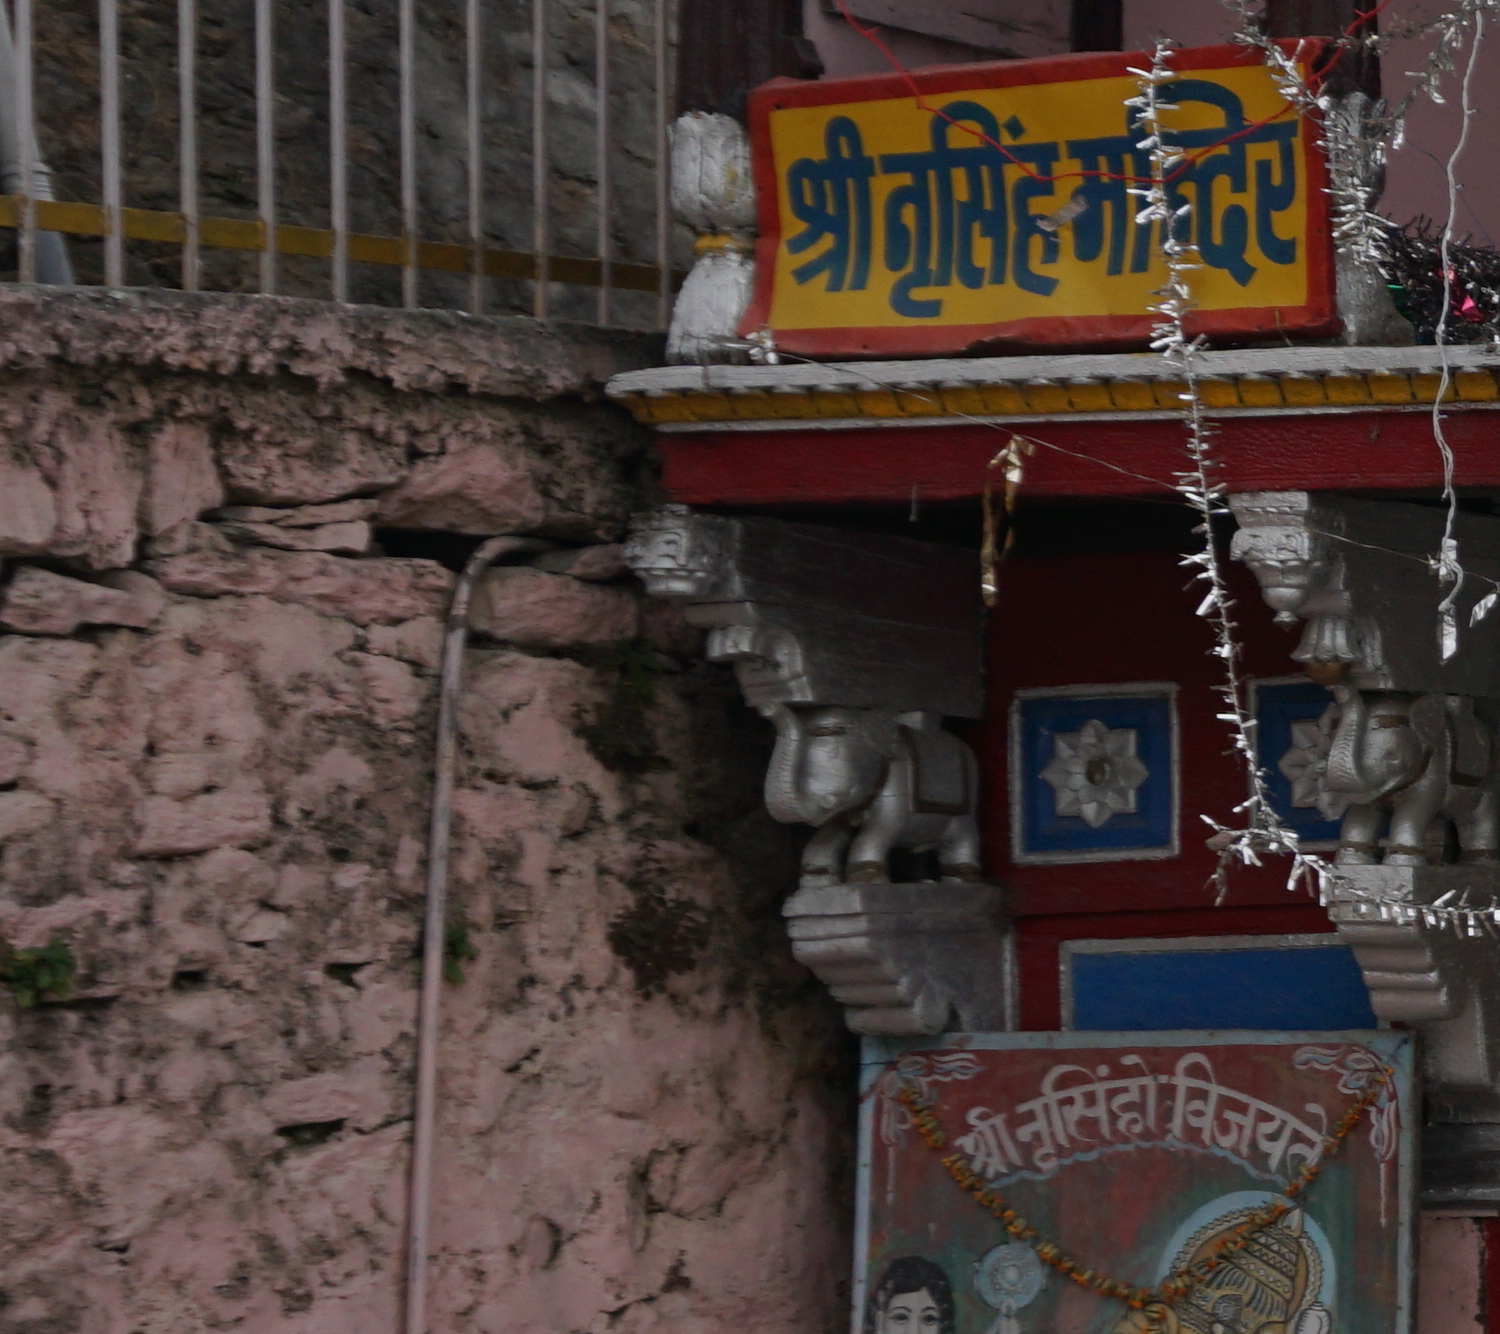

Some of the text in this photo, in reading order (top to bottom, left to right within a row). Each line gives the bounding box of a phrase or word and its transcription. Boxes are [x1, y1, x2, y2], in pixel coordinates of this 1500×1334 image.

[786, 114, 875, 293] श्री
[879, 99, 1060, 319] नृसिंह
[953, 1104, 1021, 1180] श्री
